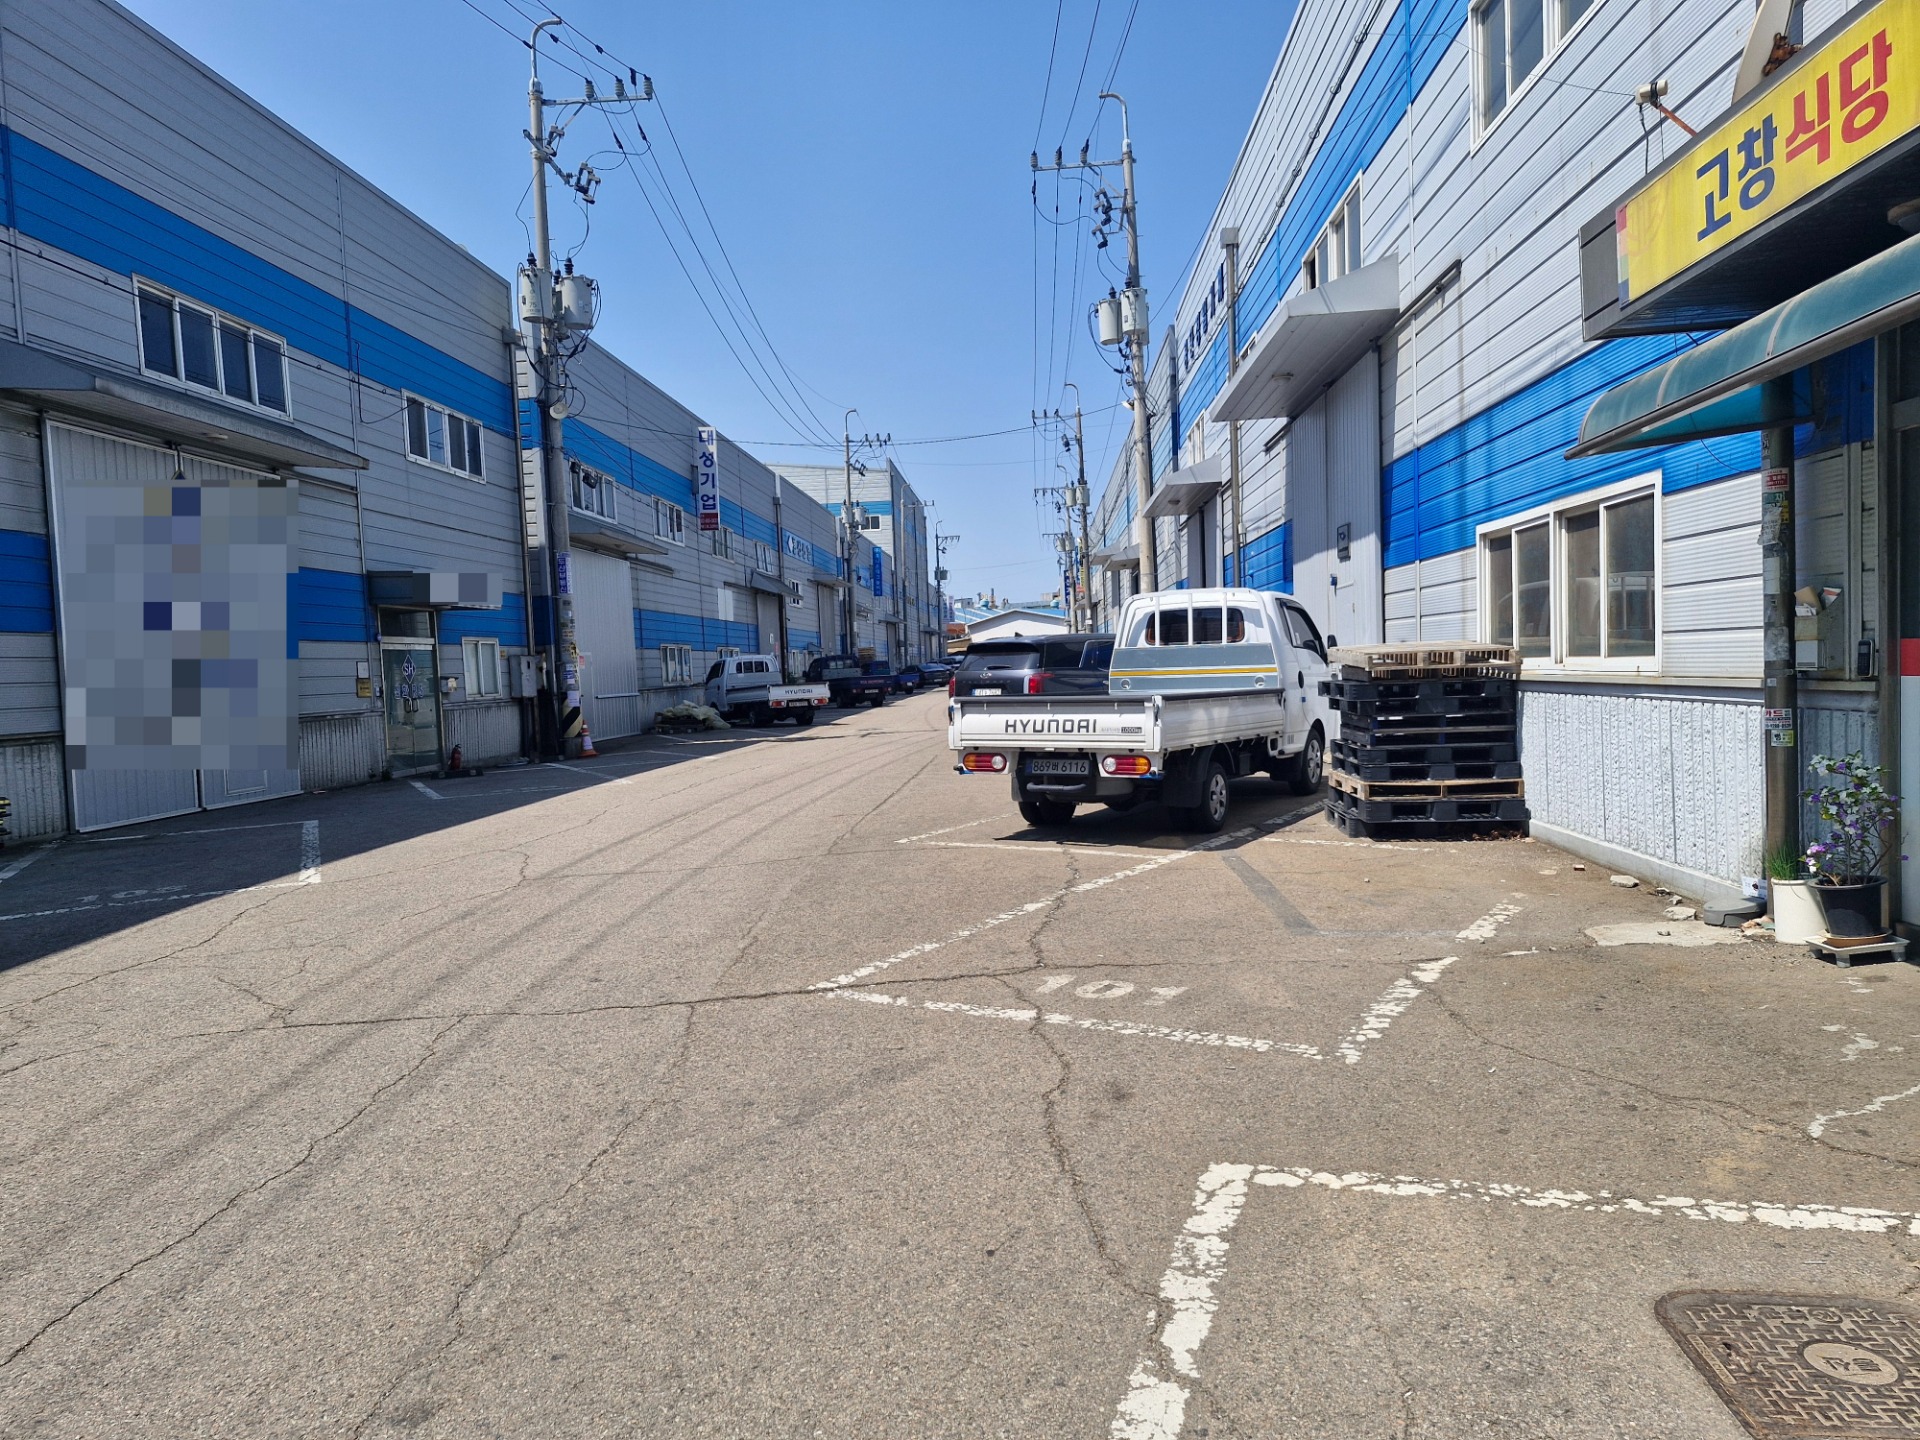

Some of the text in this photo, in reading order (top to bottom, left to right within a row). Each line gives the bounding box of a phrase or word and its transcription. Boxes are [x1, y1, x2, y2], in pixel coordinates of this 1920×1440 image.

[1695, 28, 1893, 242] 고창식당
[699, 430, 717, 511] 대성기업
[404, 663, 414, 675] SH
[1005, 719, 1097, 733] HYUNDAI
[1061, 761, 1087, 772] 6116
